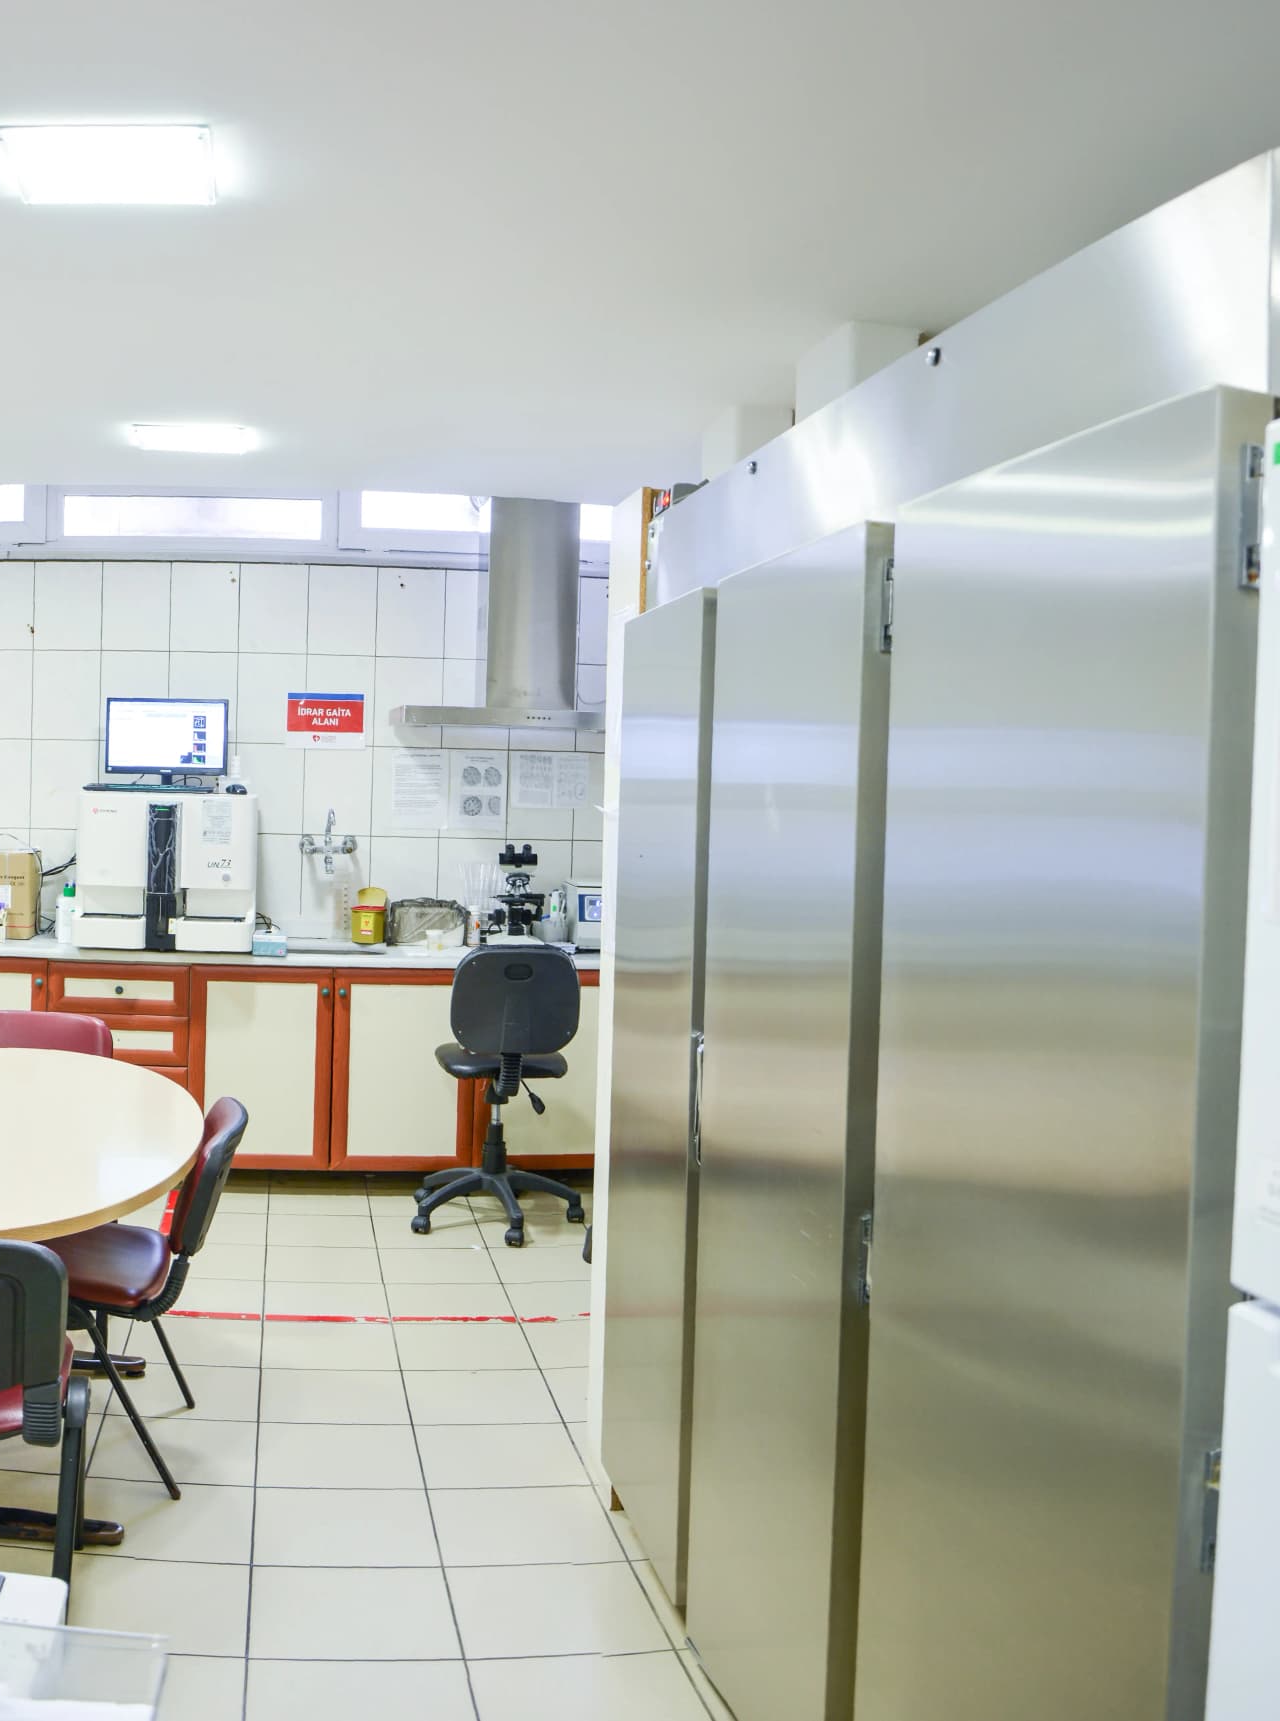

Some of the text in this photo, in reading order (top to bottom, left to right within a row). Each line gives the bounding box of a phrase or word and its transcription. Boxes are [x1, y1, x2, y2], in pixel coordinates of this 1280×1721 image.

[298, 706, 352, 717] İDRAR GAİTA
[311, 718, 339, 726] ALANI
